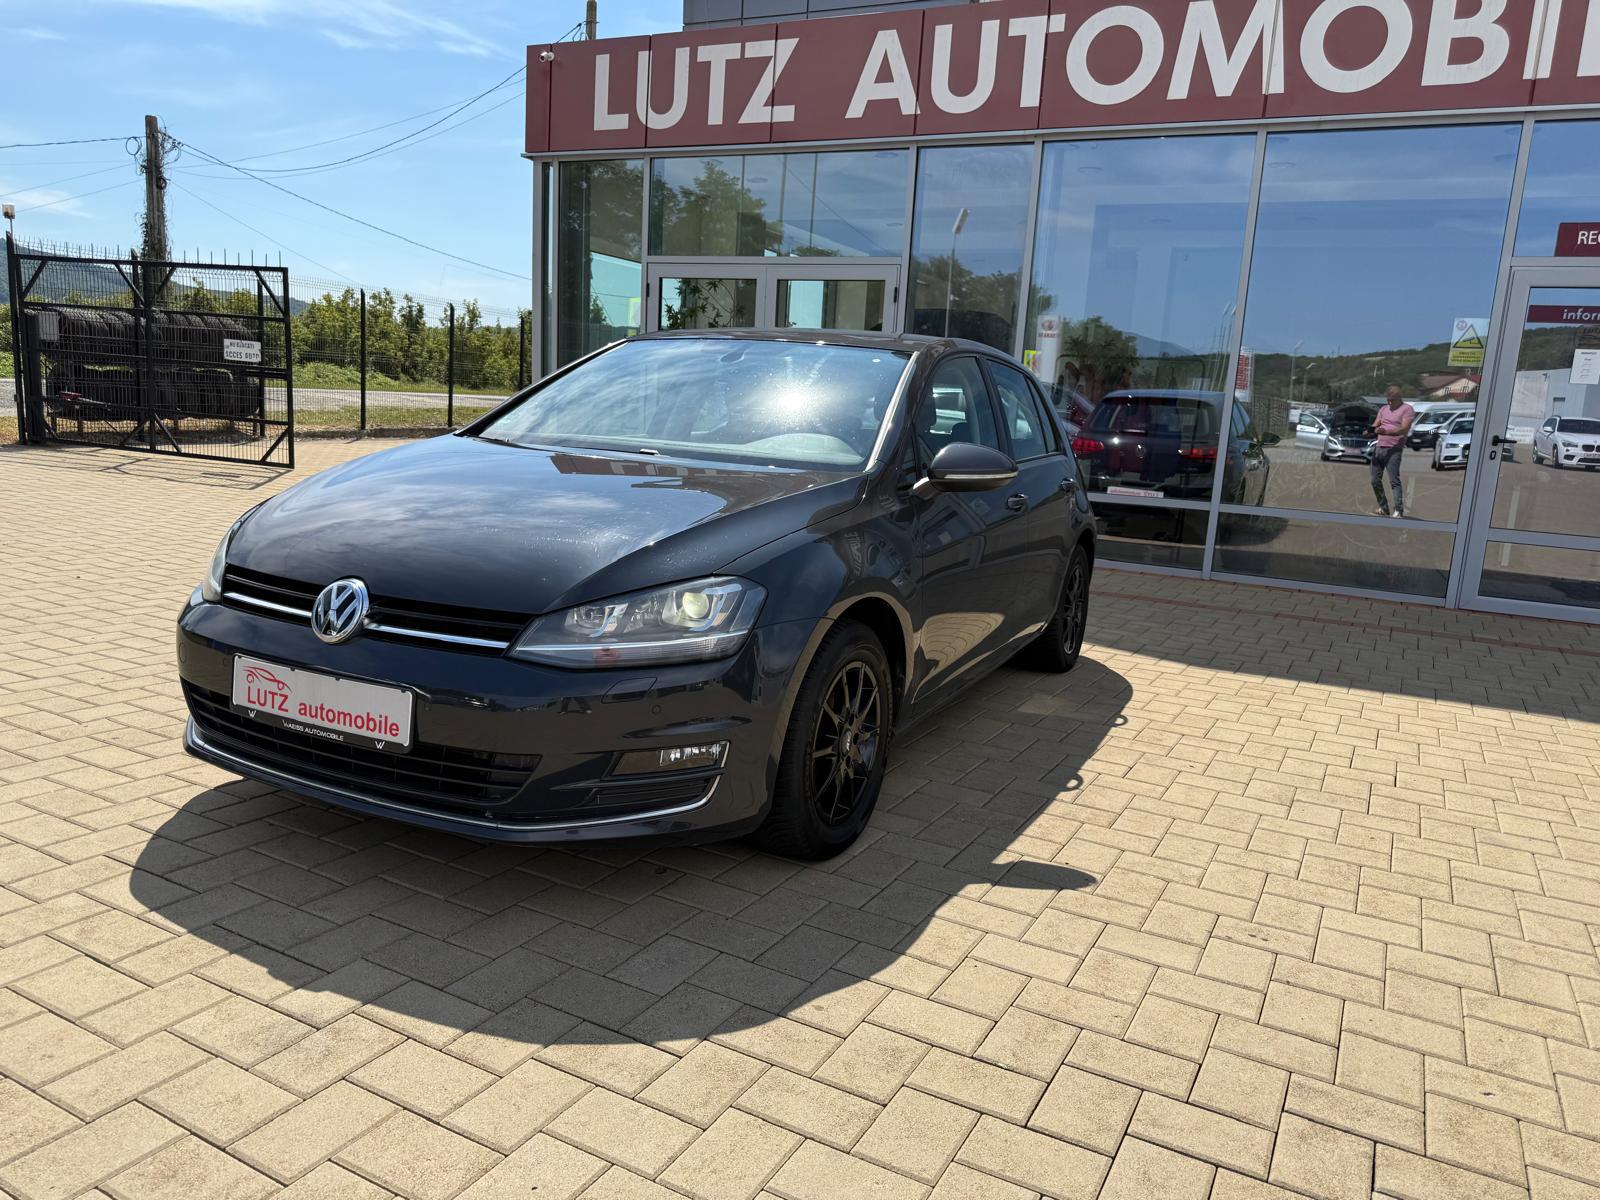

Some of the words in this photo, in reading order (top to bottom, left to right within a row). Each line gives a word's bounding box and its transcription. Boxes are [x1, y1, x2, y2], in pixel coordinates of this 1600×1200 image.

[593, 37, 800, 131] LUTZ
[1577, 230, 1600, 245] RE
[1562, 308, 1600, 320] infor
[246, 686, 289, 713] LUTZ
[298, 702, 400, 737] automobile
[304, 727, 344, 742] AUTOMOBILE
